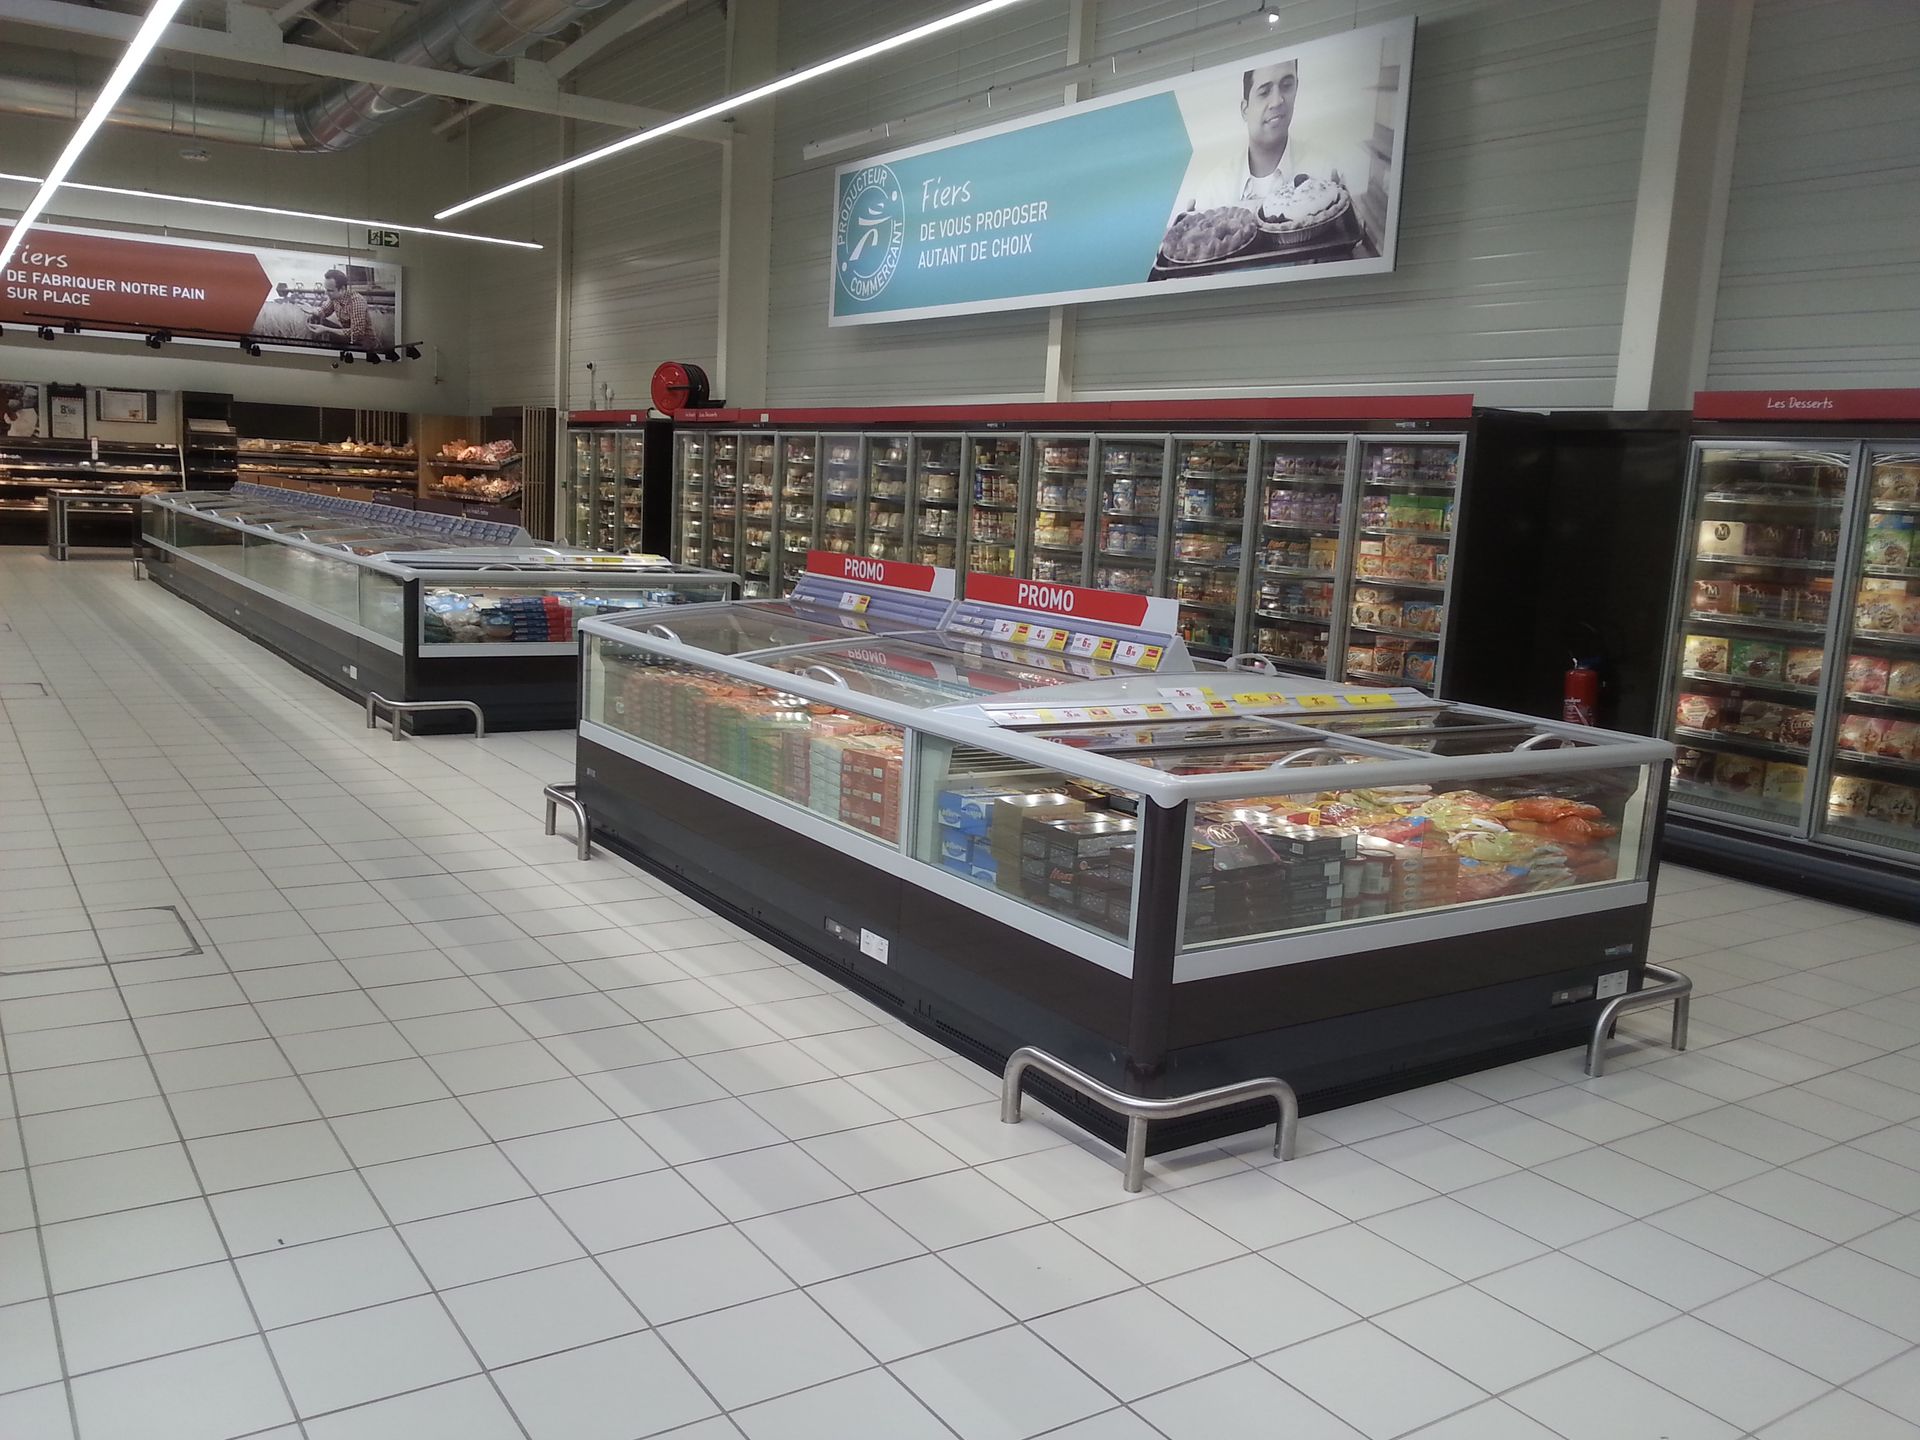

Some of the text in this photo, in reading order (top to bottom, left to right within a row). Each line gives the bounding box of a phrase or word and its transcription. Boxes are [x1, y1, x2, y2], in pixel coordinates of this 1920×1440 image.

[837, 167, 888, 246] PRODUCTEUR
[922, 176, 972, 213] Fiers
[919, 200, 1049, 242] DE VOUS PROPOSER
[9, 243, 69, 269] iers
[849, 220, 904, 297] COMMERÇANT
[917, 233, 1033, 270] AUTANT DE CHOIX
[6, 269, 206, 301] DE FABRIQUER NOTRE PAIN
[6, 287, 91, 306] SUR PLACE
[1767, 396, 1834, 410] Les Desserts
[843, 557, 885, 582] PROMO
[1017, 583, 1075, 613] PROMO
